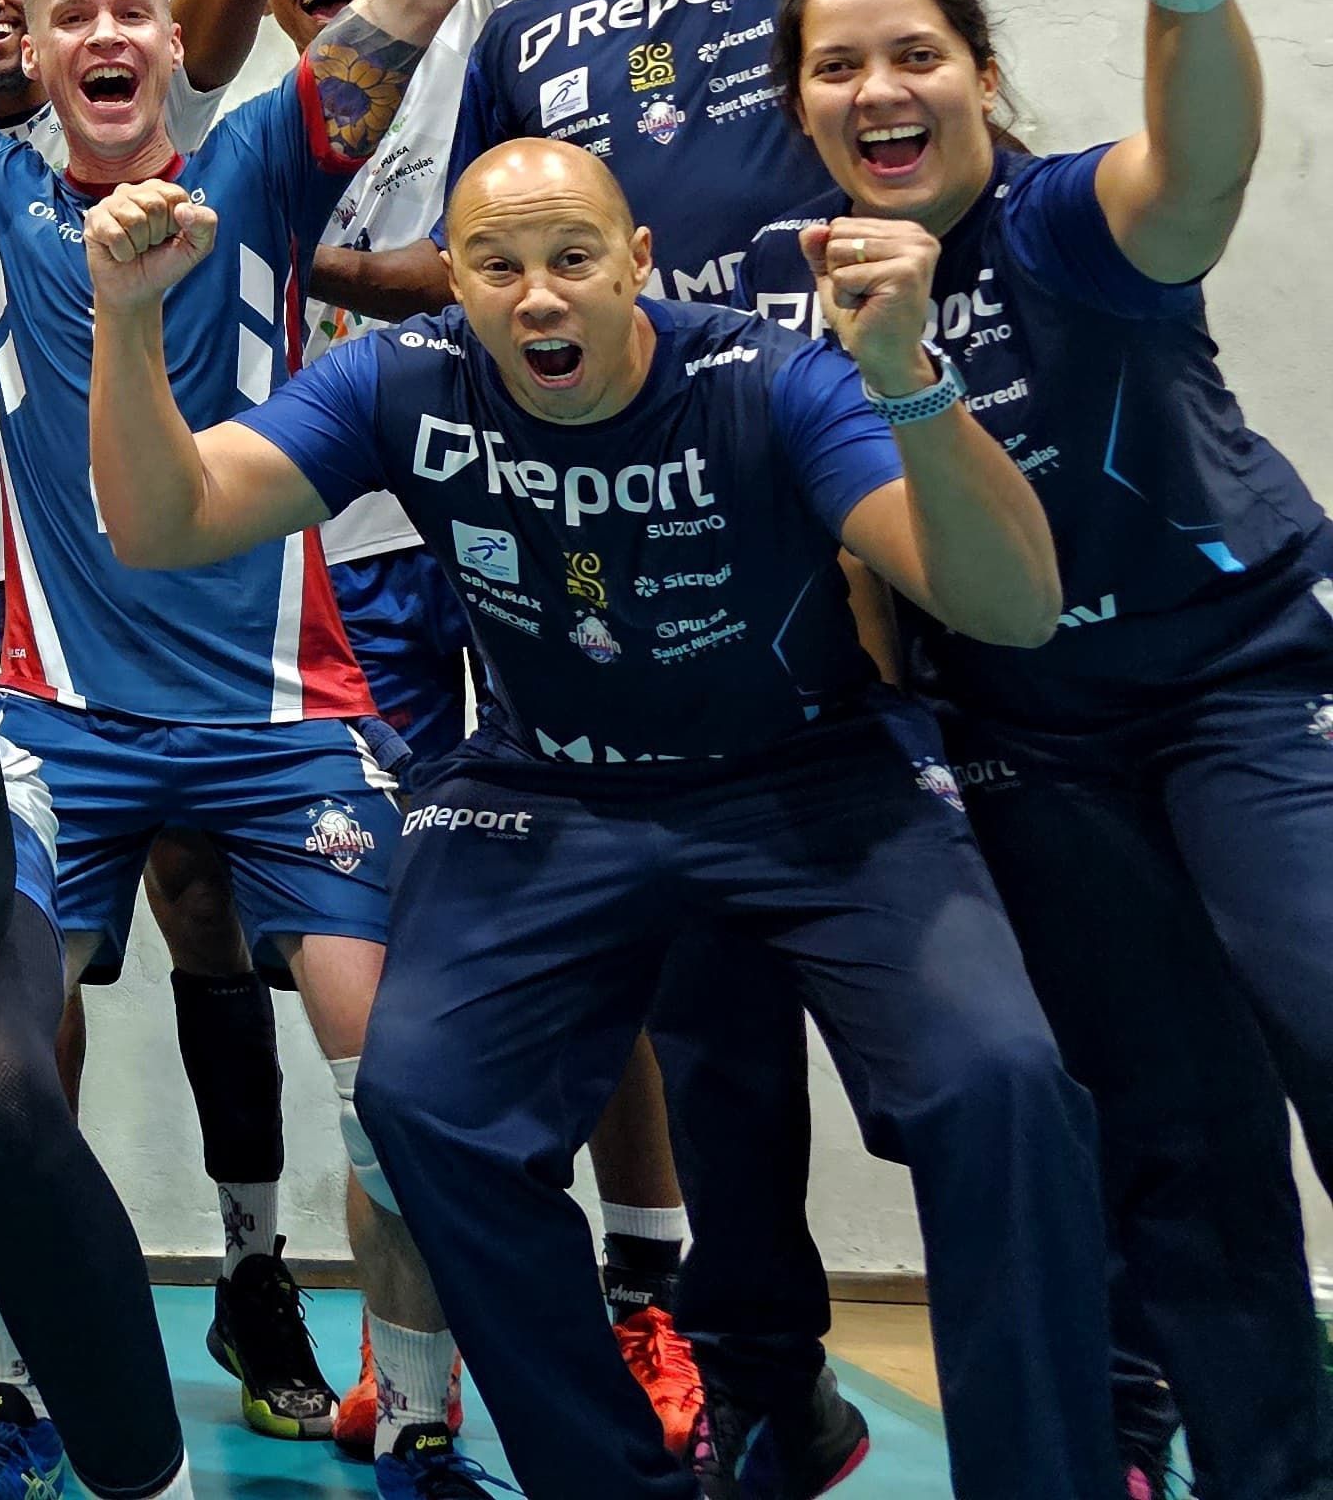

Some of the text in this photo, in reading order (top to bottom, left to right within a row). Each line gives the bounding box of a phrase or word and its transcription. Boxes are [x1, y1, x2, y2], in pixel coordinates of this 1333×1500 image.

[638, 111, 686, 132] SUZANO
[706, 102, 740, 119] Saint
[715, 100, 778, 125] MEDICA
[546, 113, 611, 140] RAMAX
[583, 138, 612, 155] ORE
[673, 251, 746, 299] MR
[427, 337, 467, 360] NAGU
[963, 324, 1013, 363] sano
[965, 377, 1029, 413] icredi
[1017, 445, 1060, 472] holas
[485, 430, 716, 528] Report
[646, 514, 726, 539] suzano
[663, 563, 732, 589] Sicredi
[679, 607, 728, 634] PULSA
[691, 620, 748, 649] Nicholas
[418, 804, 534, 834] Report
[305, 830, 375, 852] SUZANO
[426, 1435, 448, 1447] asics
